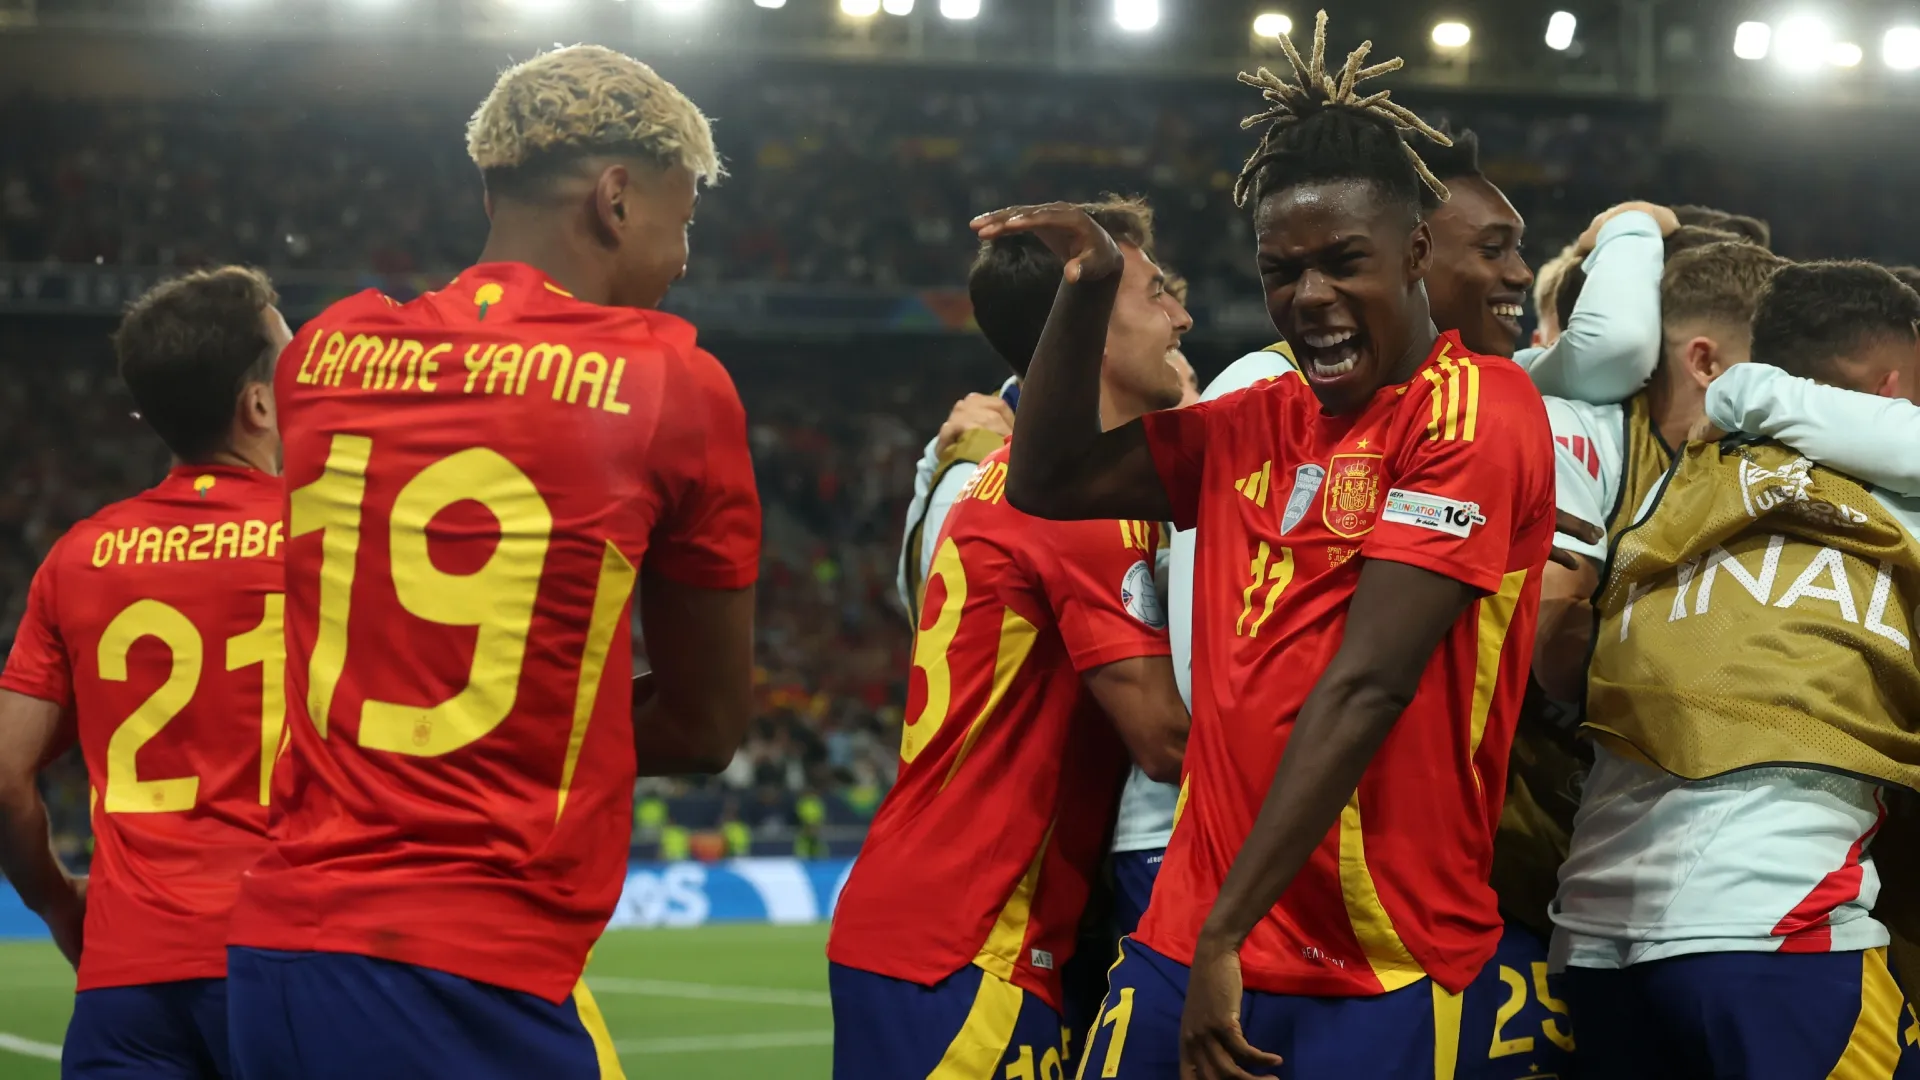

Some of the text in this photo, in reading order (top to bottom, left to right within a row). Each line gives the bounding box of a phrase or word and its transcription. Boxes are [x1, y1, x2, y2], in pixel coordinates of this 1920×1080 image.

[296, 328, 631, 415] LAMINE YAMAL
[1386, 500, 1442, 518] FOUNDATION
[1444, 506, 1470, 527] 10
[290, 434, 553, 757] 19
[1236, 540, 1295, 638] 11
[97, 592, 287, 813] 21
[1488, 961, 1576, 1060] 25
